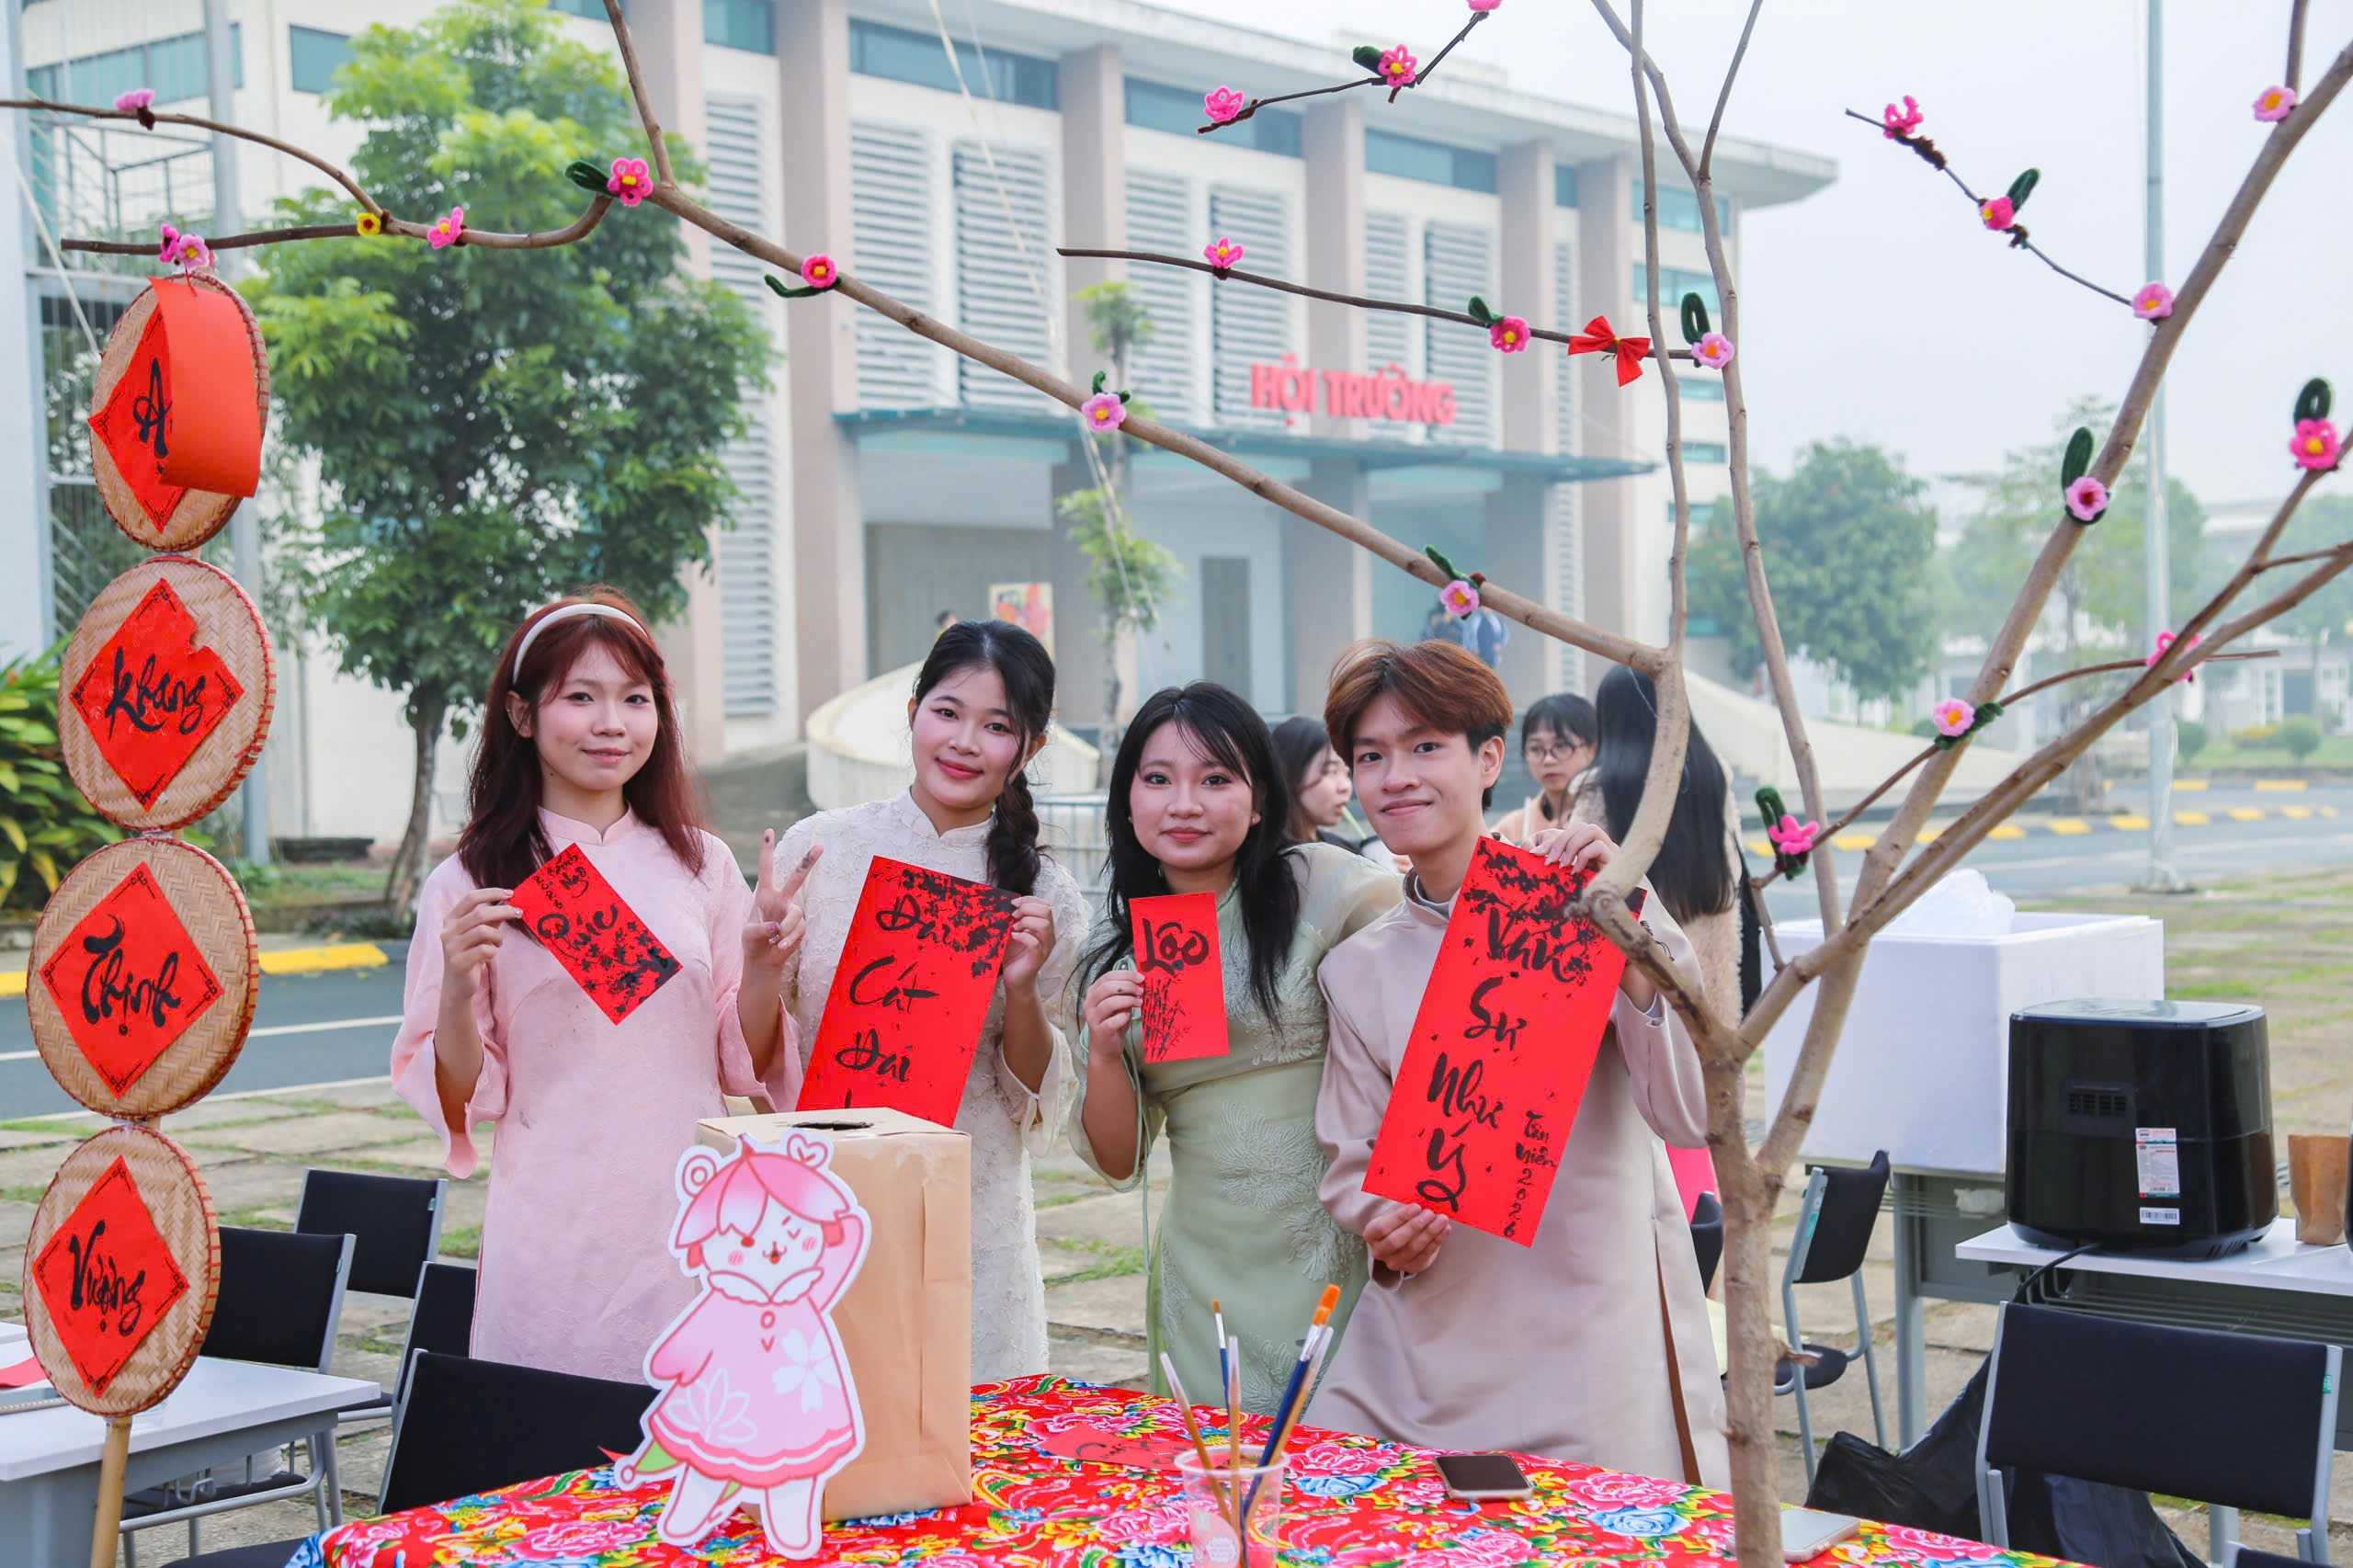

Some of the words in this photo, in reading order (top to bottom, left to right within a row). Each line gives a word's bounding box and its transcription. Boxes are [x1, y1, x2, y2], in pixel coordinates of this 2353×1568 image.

[1250, 353, 1316, 428] HỘI
[1322, 361, 1457, 426] TRƯỜNG
[82, 914, 182, 1036] Thịnh
[1415, 1115, 1471, 1212] Ý
